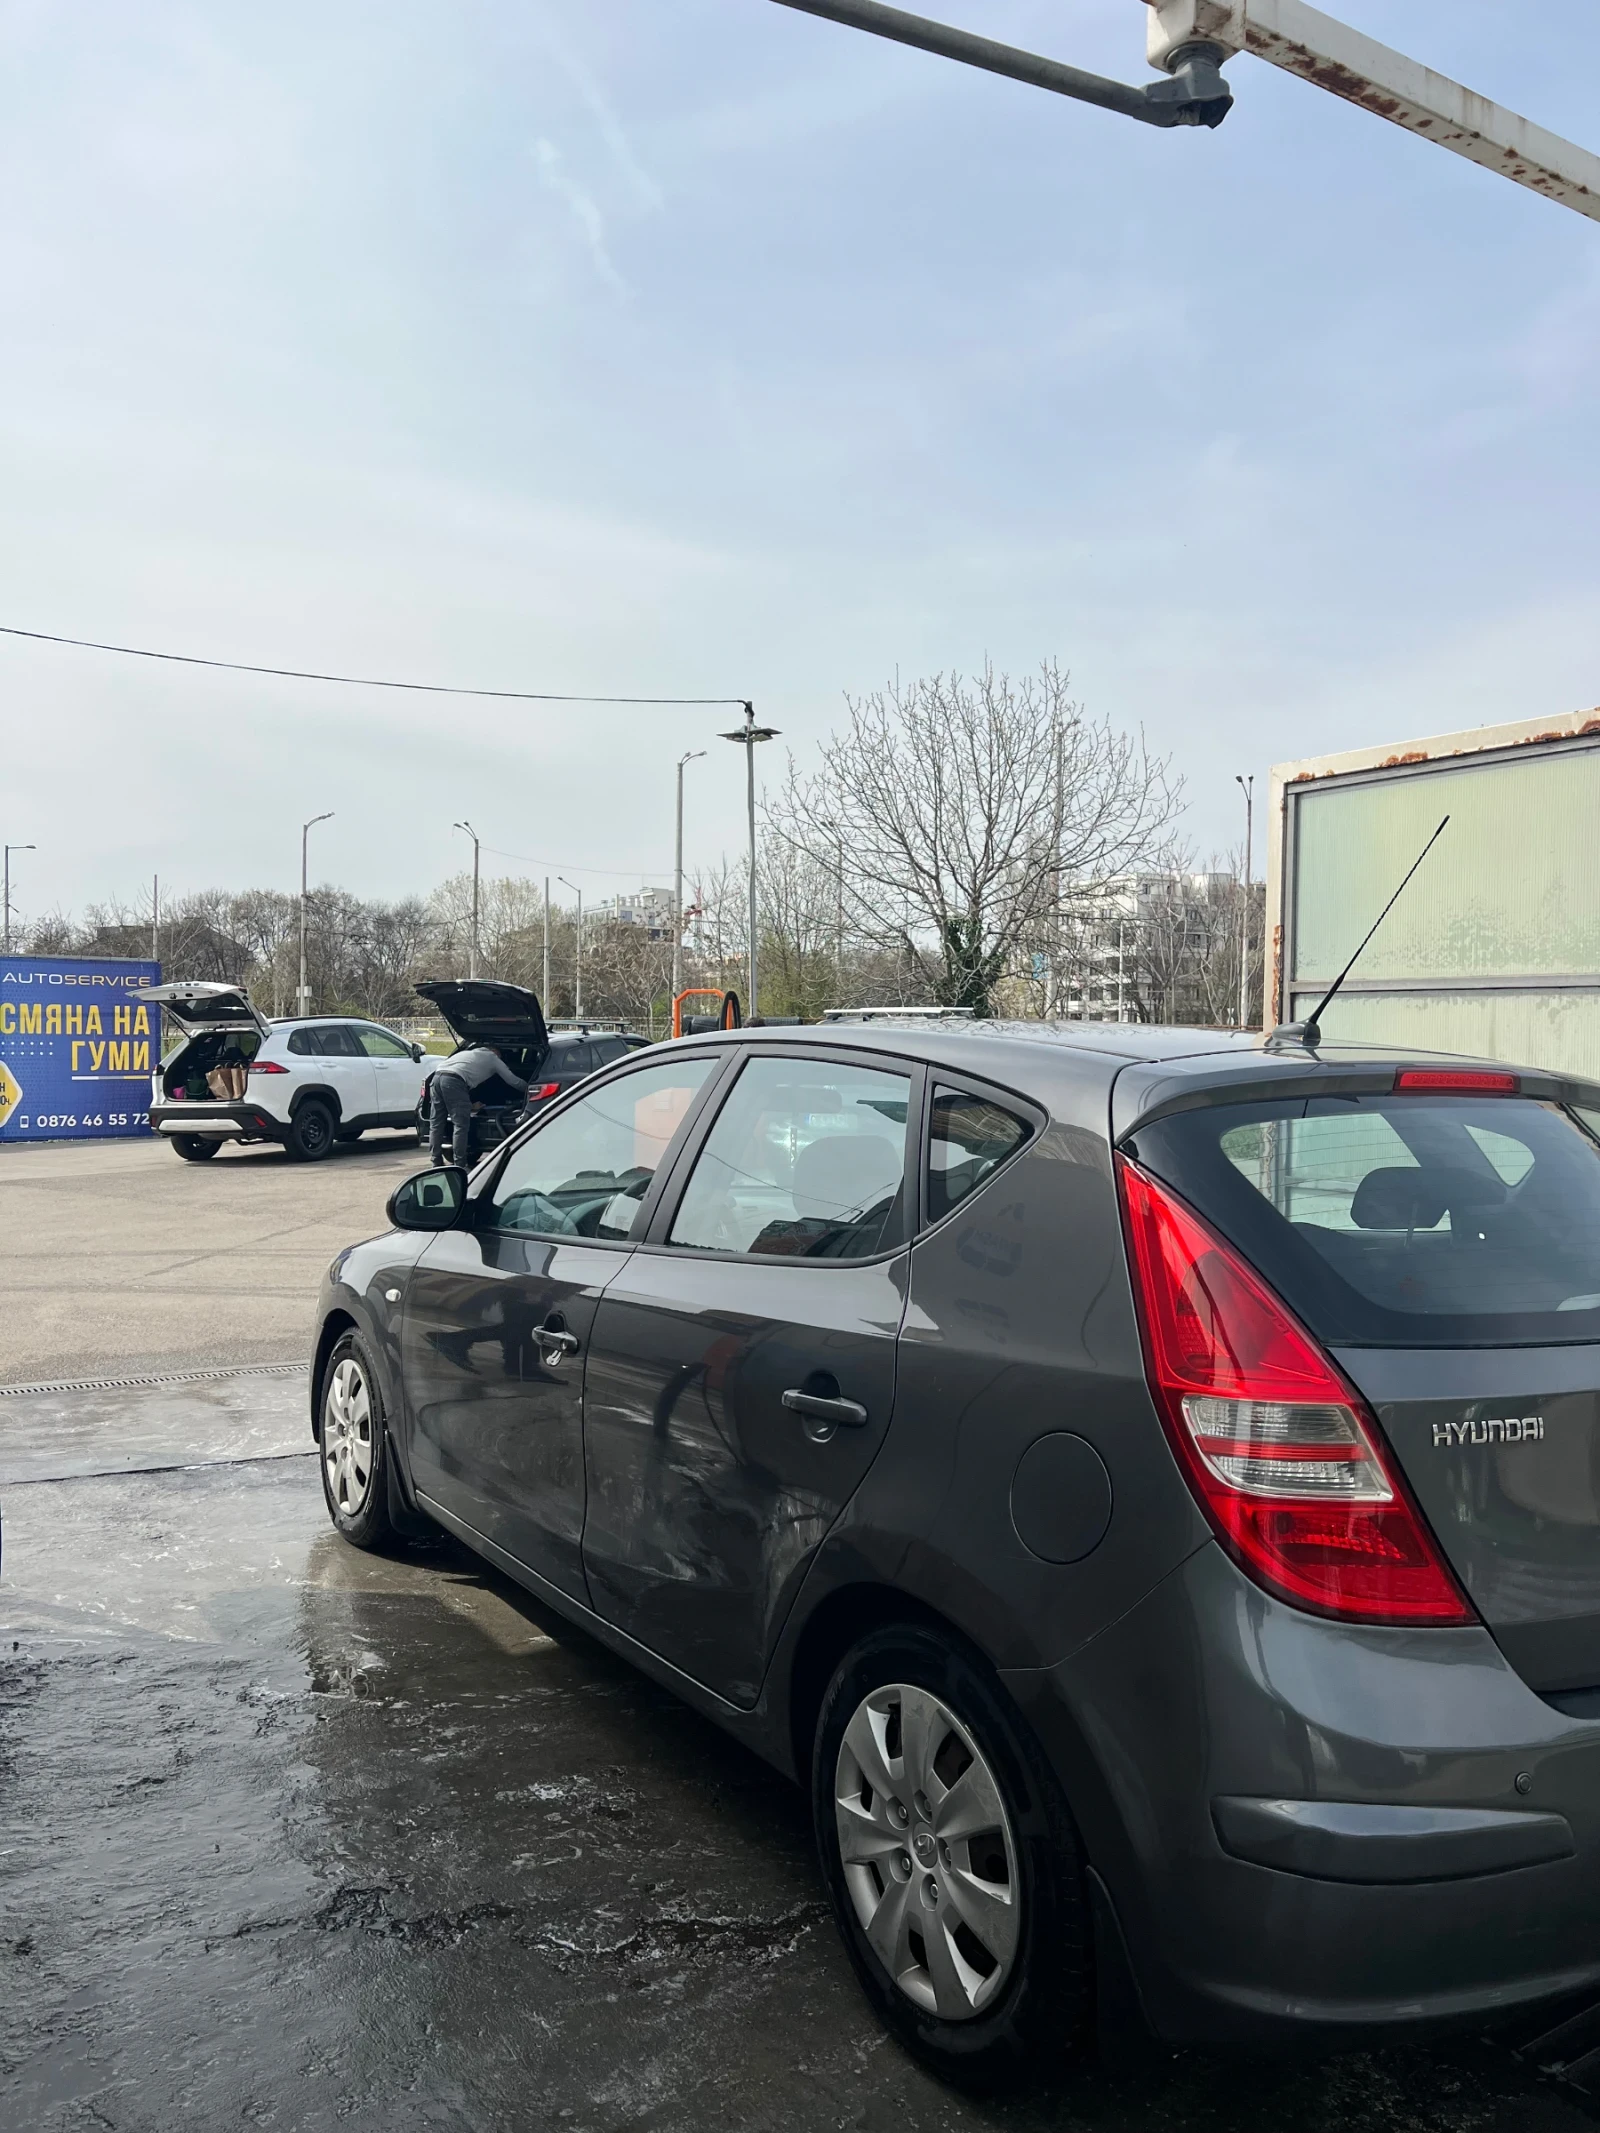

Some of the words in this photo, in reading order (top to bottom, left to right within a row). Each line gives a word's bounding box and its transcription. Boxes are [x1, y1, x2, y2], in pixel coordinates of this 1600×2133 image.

[2, 972, 151, 987] AUTOSERVICE
[0, 1003, 103, 1035] СМЯНА
[114, 1005, 150, 1035] НА
[71, 1041, 149, 1071] ГУМИ
[37, 1114, 77, 1127] 0876
[82, 1114, 103, 1127] 46
[108, 1113, 128, 1126] 55
[133, 1113, 150, 1125] 72
[1432, 1417, 1544, 1446] HYUNDAI
